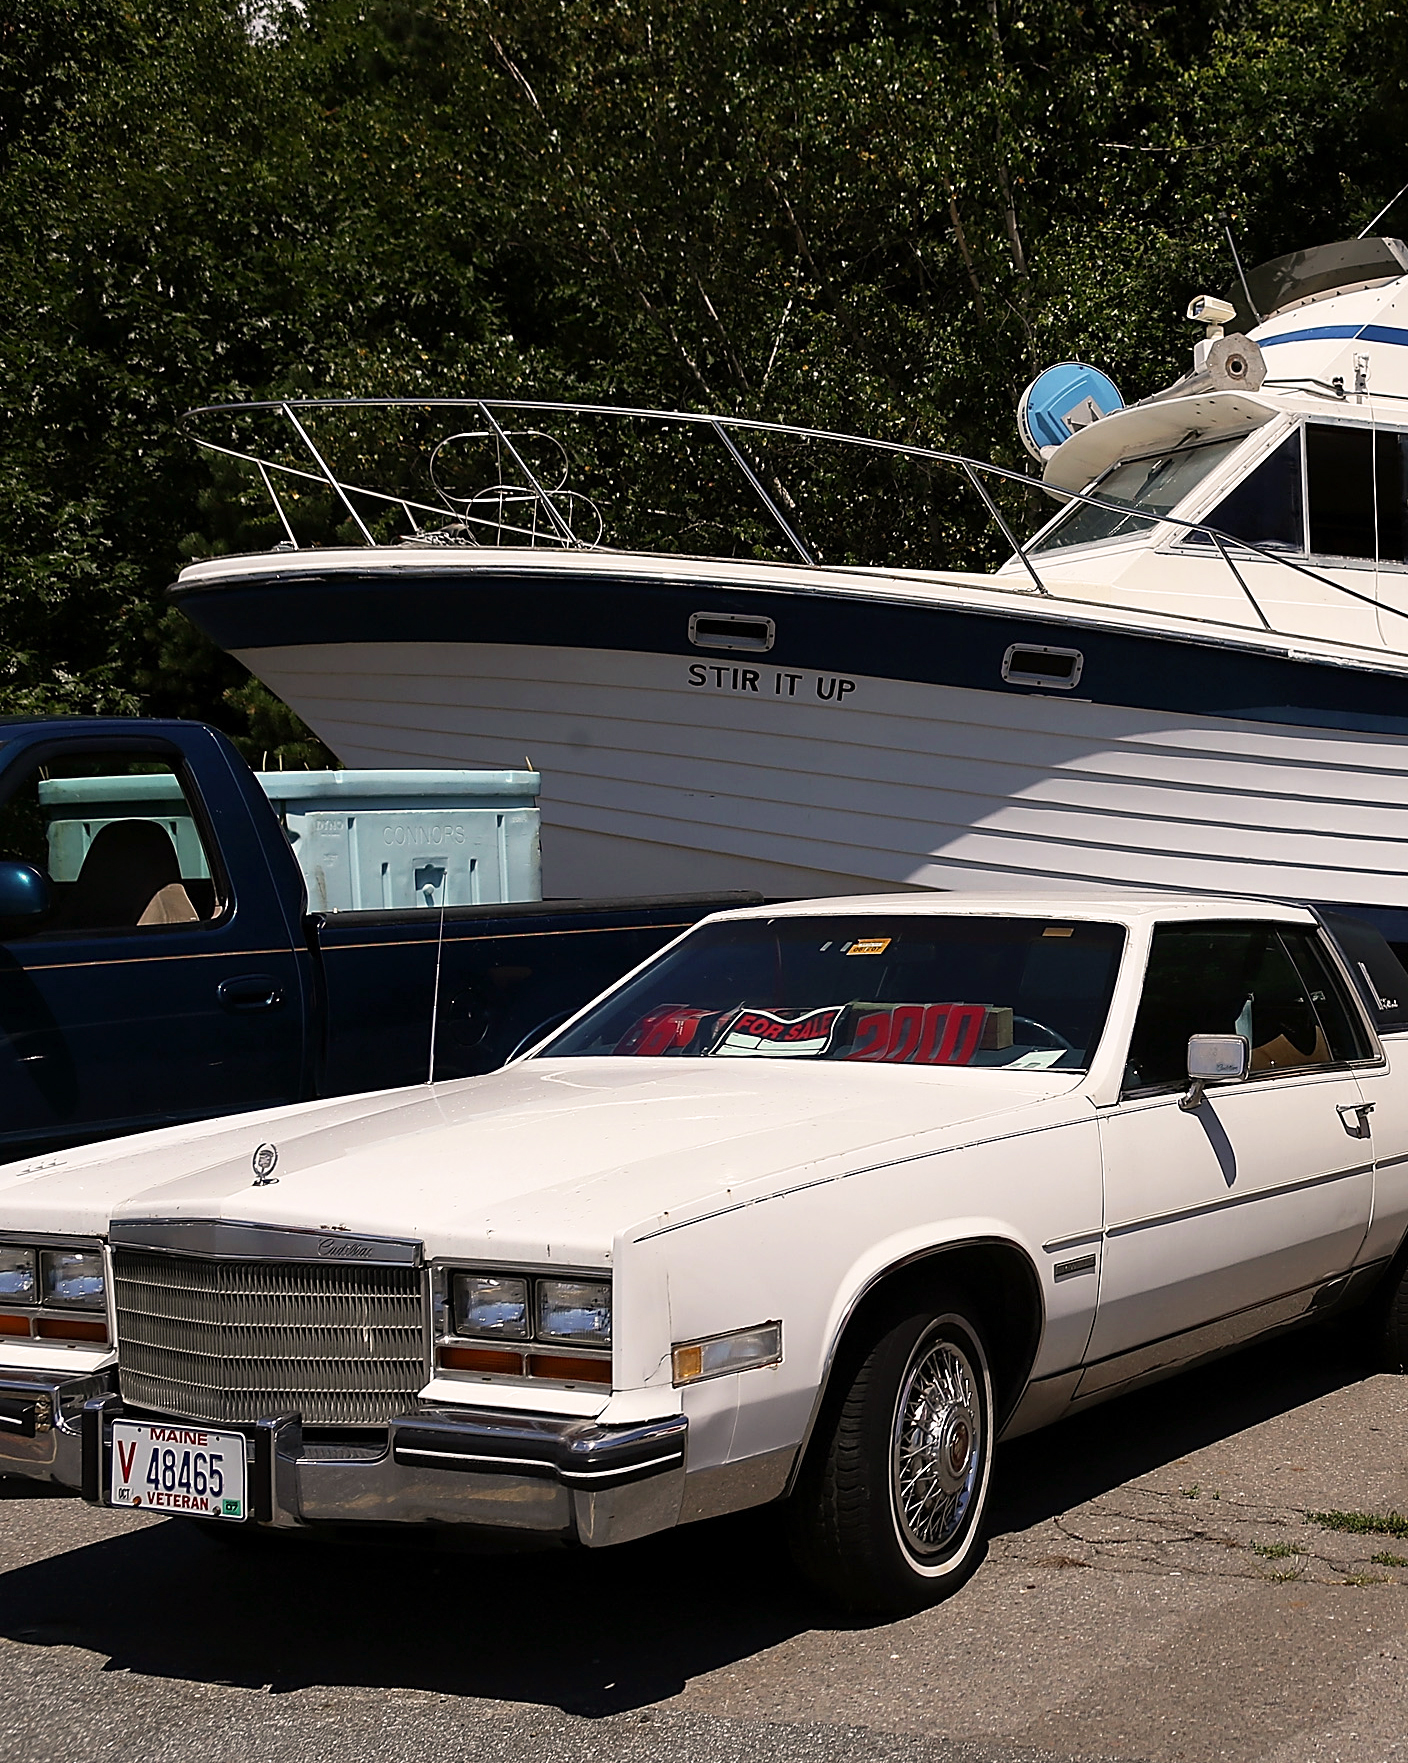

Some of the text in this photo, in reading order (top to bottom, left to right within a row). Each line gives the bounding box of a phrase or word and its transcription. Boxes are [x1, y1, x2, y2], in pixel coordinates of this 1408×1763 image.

[687, 664, 856, 702] STIR IT UP
[383, 825, 466, 846] CONNORS
[734, 1013, 785, 1040] FOR
[784, 1012, 836, 1041] SALE
[318, 1238, 373, 1258] Cadillac
[150, 1428, 208, 1447] MAINE
[117, 1440, 224, 1497] V 48465
[118, 1487, 131, 1500] OCT
[146, 1491, 209, 1511] VETERAN
[225, 1503, 238, 1511] 07
